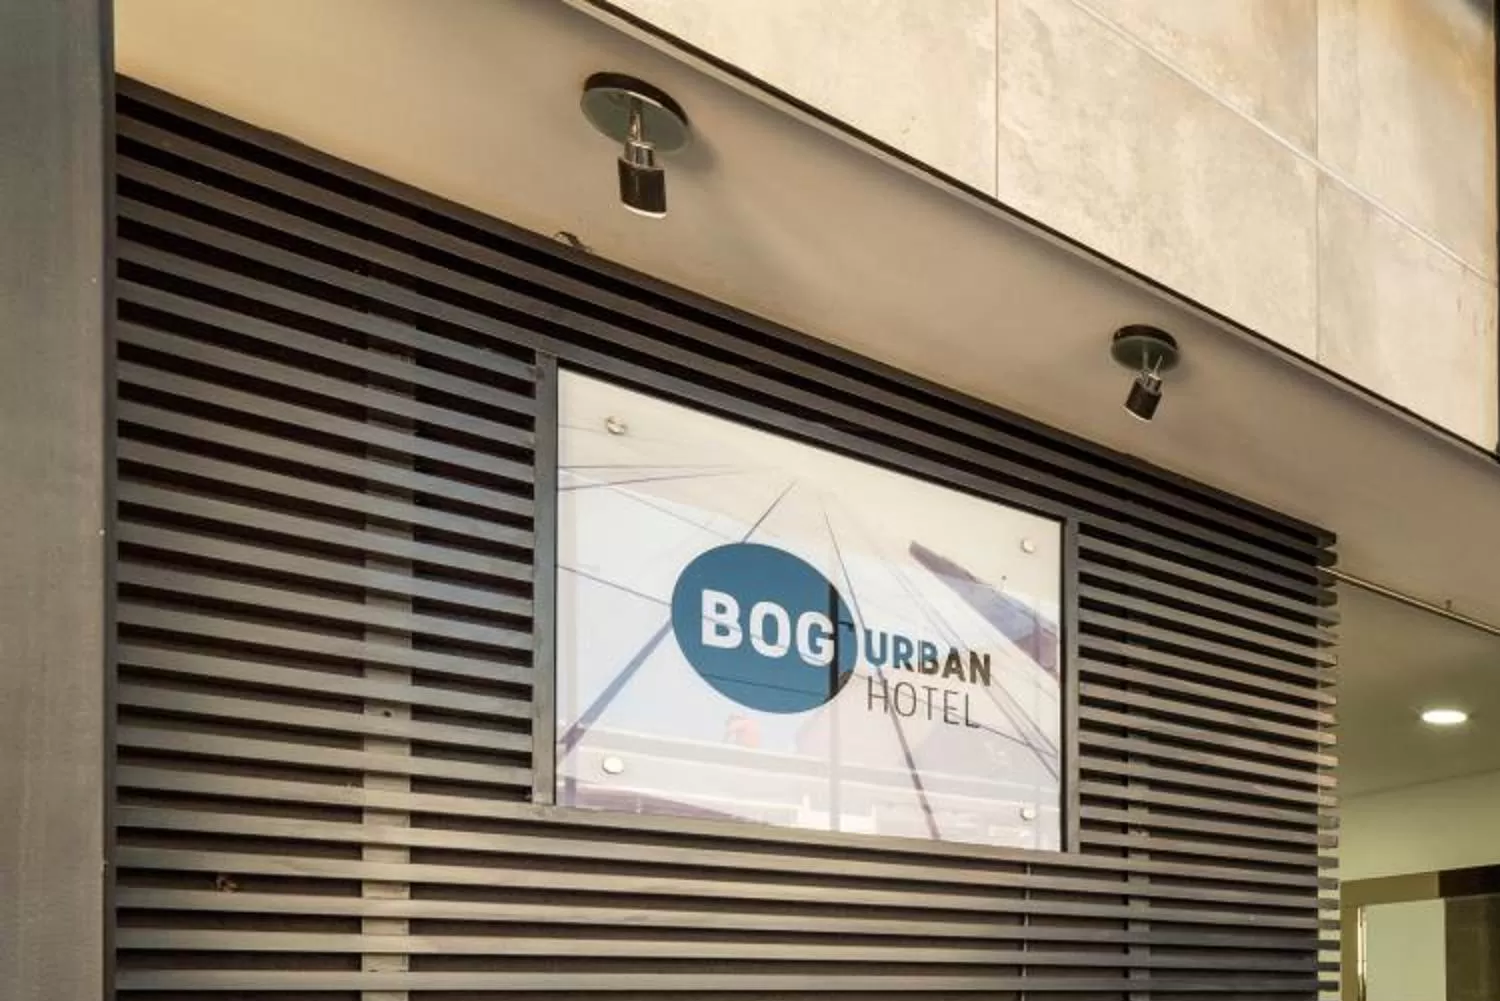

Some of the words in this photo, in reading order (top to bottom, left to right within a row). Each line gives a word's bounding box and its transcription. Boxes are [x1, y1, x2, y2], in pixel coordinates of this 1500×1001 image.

[701, 588, 835, 667] BOG
[864, 628, 991, 687] URBAN
[867, 676, 980, 728] HOTEL
